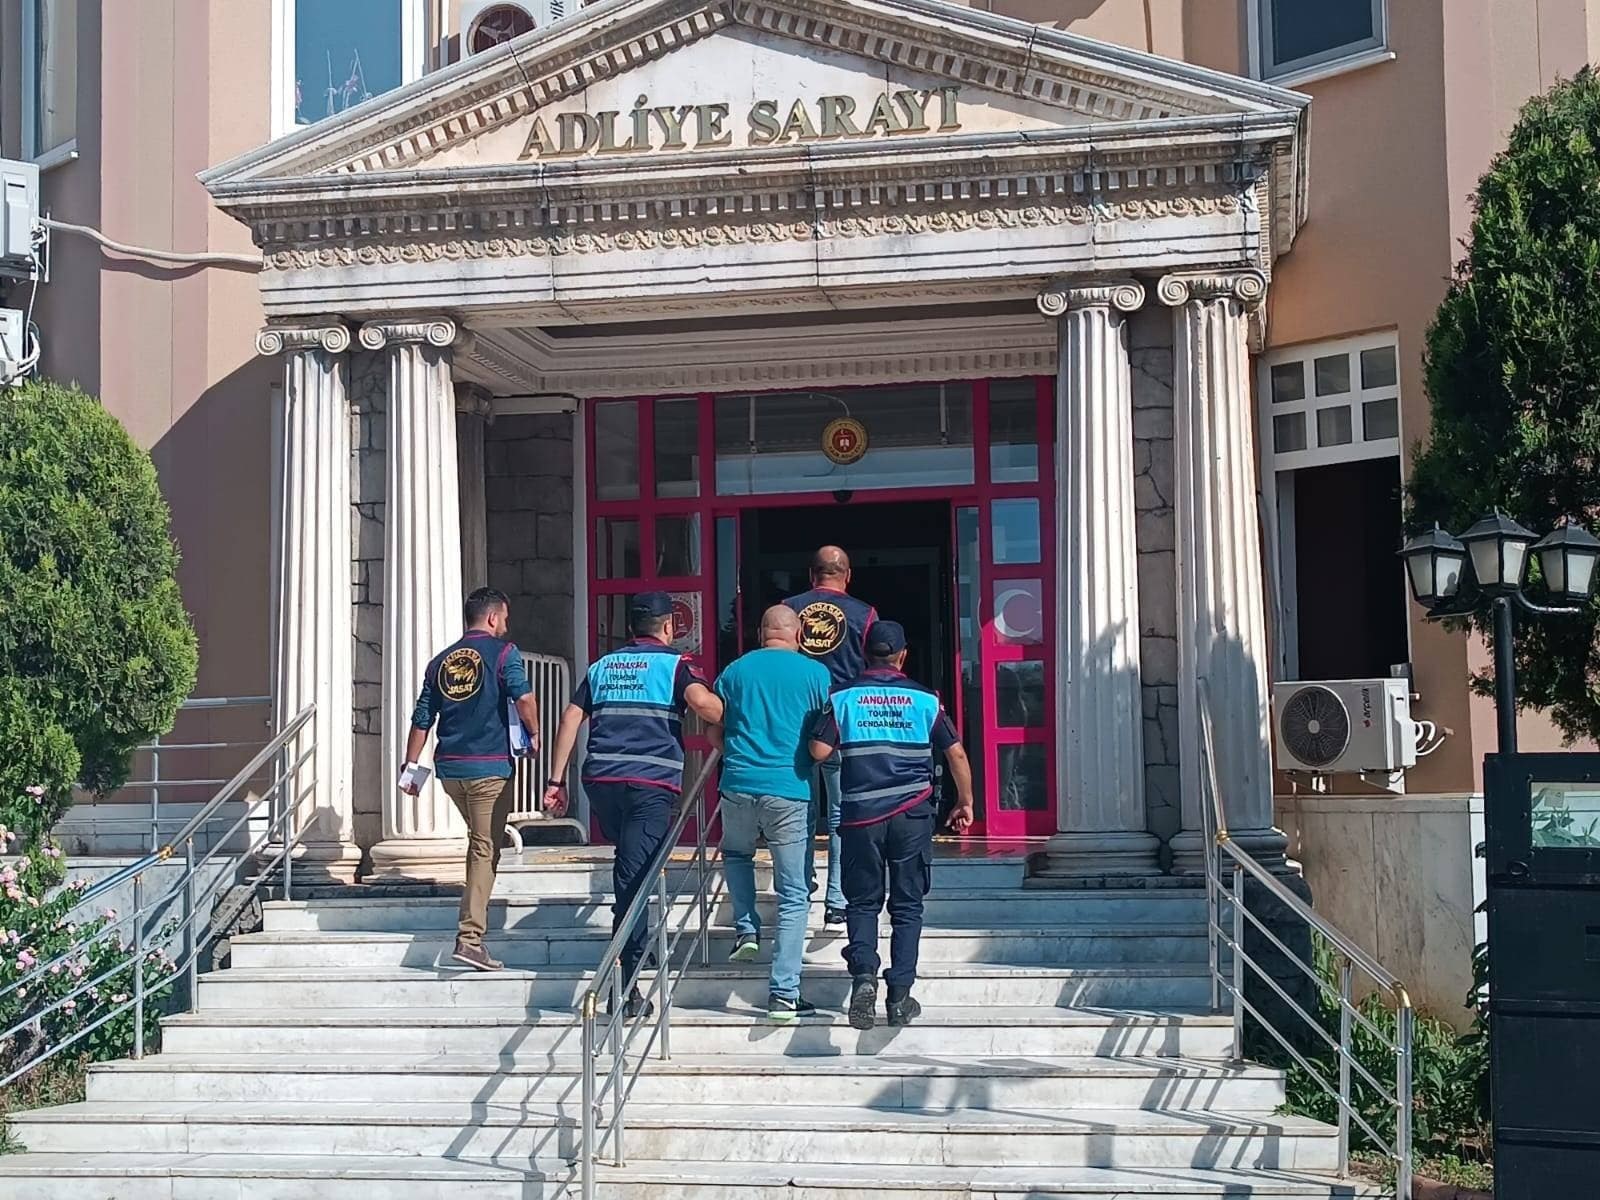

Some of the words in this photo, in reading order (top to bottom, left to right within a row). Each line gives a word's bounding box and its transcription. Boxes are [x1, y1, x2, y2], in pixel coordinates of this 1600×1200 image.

[517, 93, 732, 160] ADLİYE
[746, 86, 961, 146] SARAYI
[803, 638, 834, 648] JASAT
[857, 695, 913, 706] JANDARMA
[867, 710, 903, 718] TOURISM
[857, 720, 913, 729] GENDARMERIE
